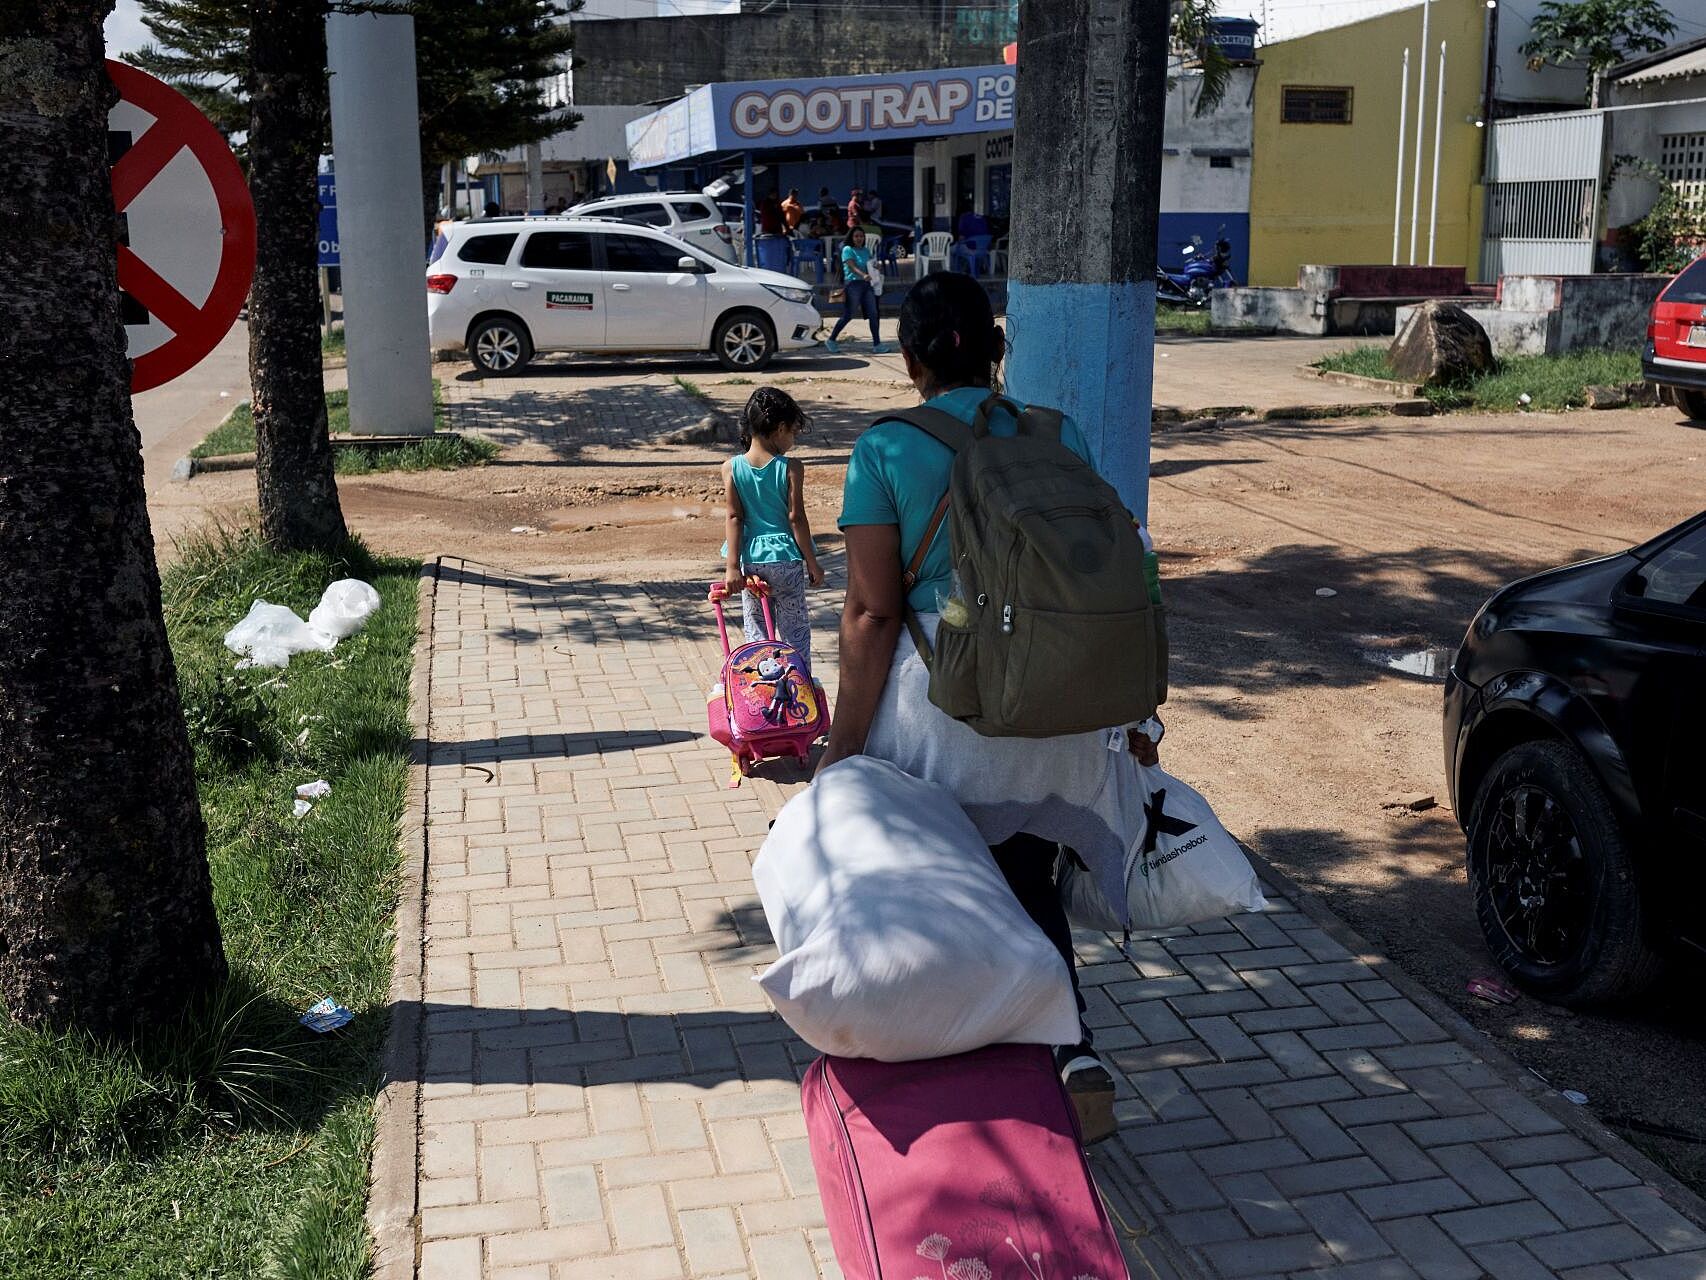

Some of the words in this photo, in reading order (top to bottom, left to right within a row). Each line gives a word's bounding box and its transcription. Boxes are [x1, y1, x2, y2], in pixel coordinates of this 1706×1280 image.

[733, 83, 969, 135] COOTRAP
[976, 98, 1013, 122] DE
[551, 293, 590, 304] PACARAIMA
